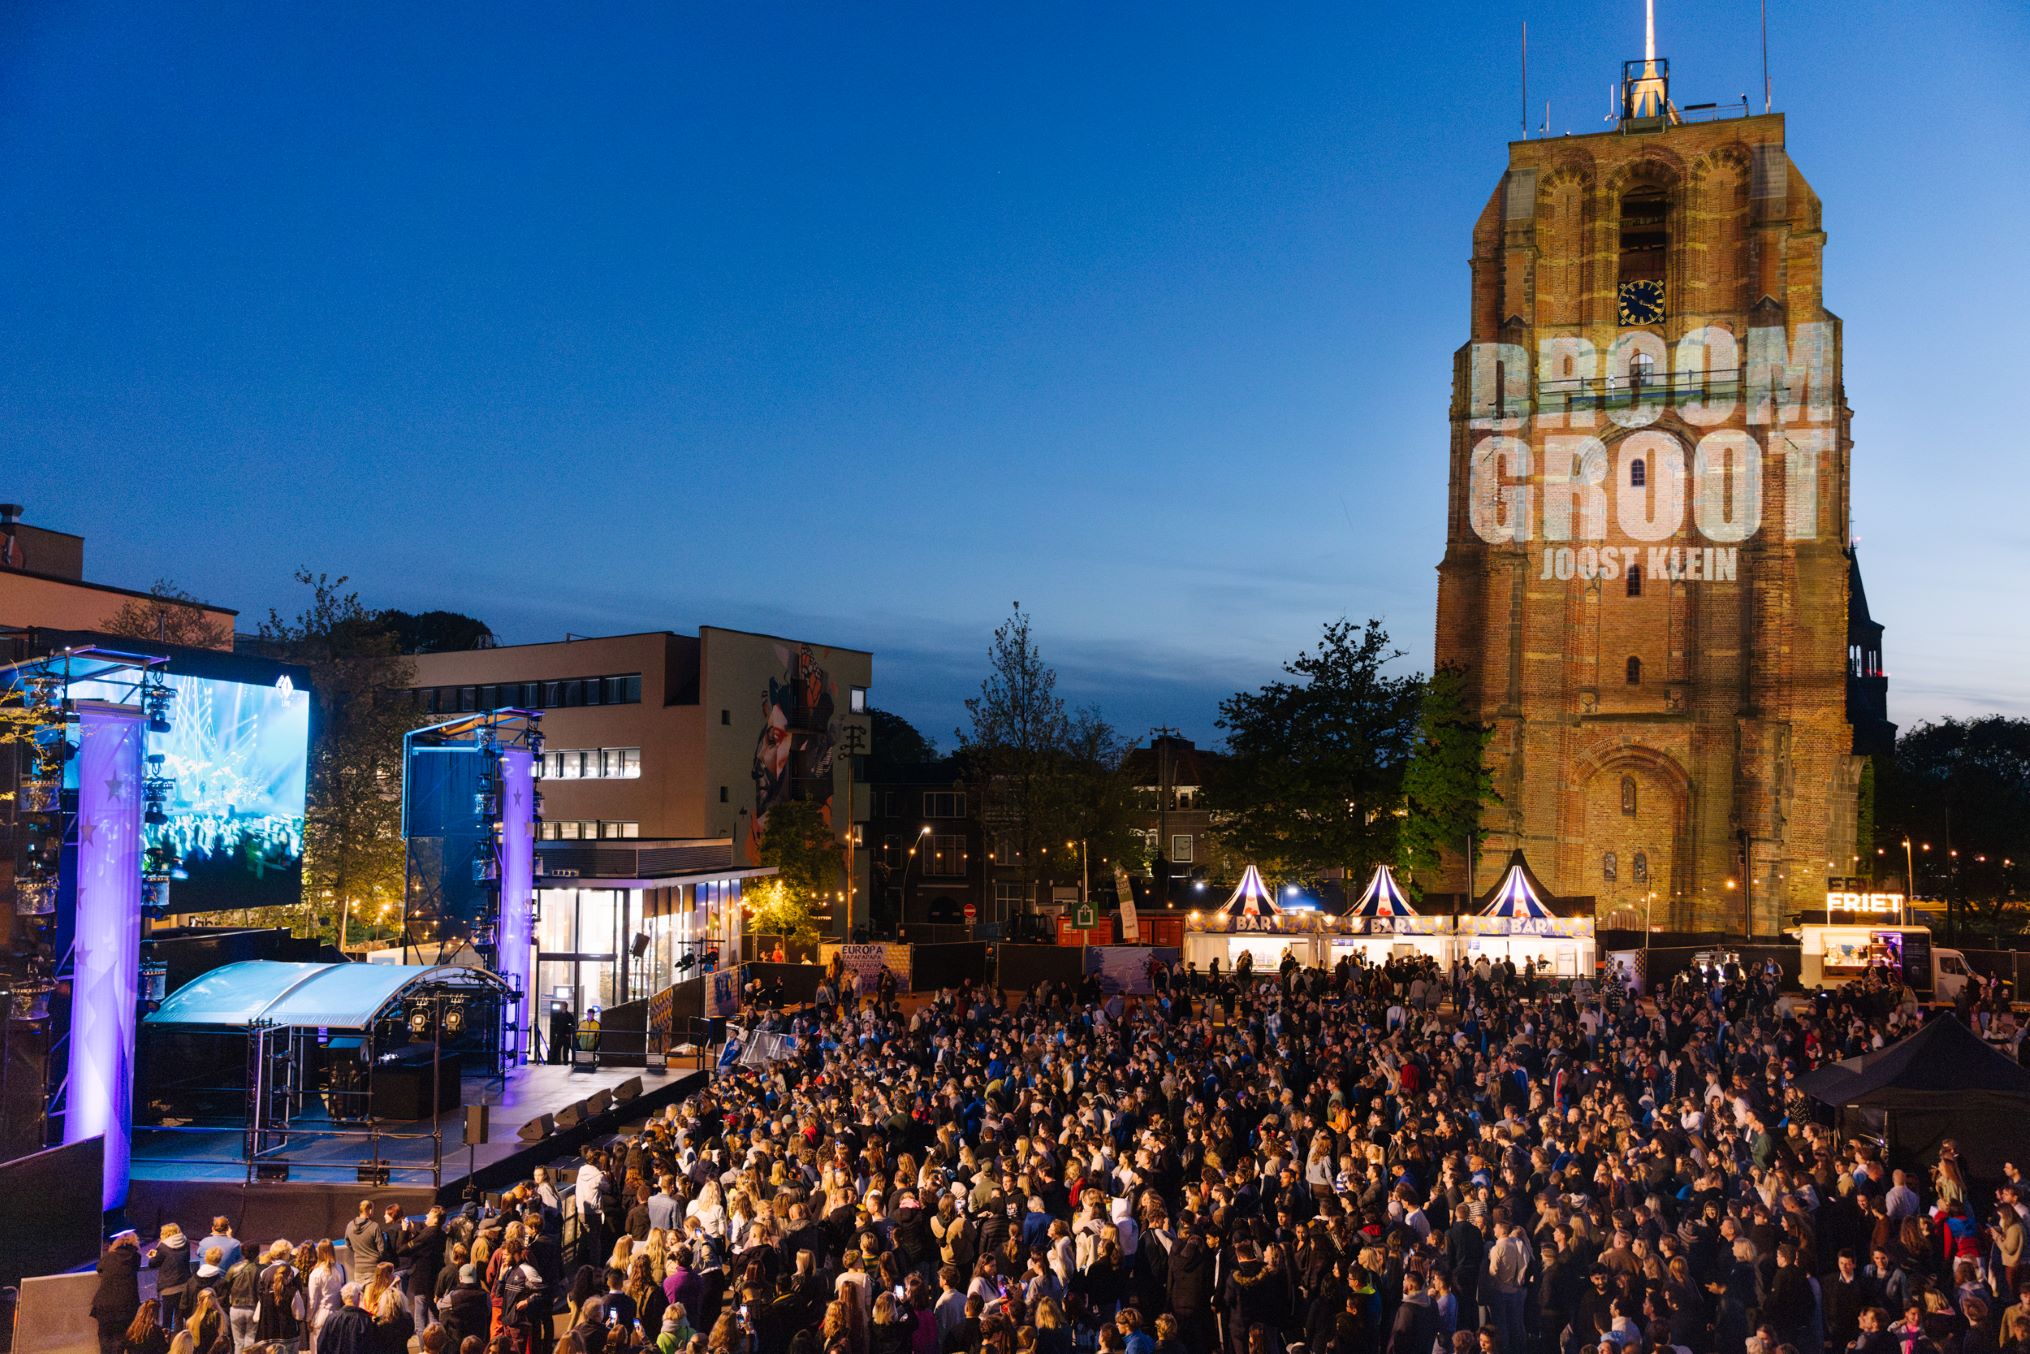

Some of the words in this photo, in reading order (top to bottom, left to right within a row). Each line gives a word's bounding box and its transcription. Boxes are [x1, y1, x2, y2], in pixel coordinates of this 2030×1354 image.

[1470, 321, 1834, 430] DROOM
[1469, 428, 1837, 544] GROOT
[1540, 546, 1640, 581] JOOST
[1647, 546, 1737, 581] KLEIN
[1827, 893, 1904, 913] FRIET
[1236, 915, 1271, 931] BAR
[1371, 917, 1408, 933] BAR
[1510, 917, 1548, 934] BAR
[842, 945, 883, 955] EUROPA
